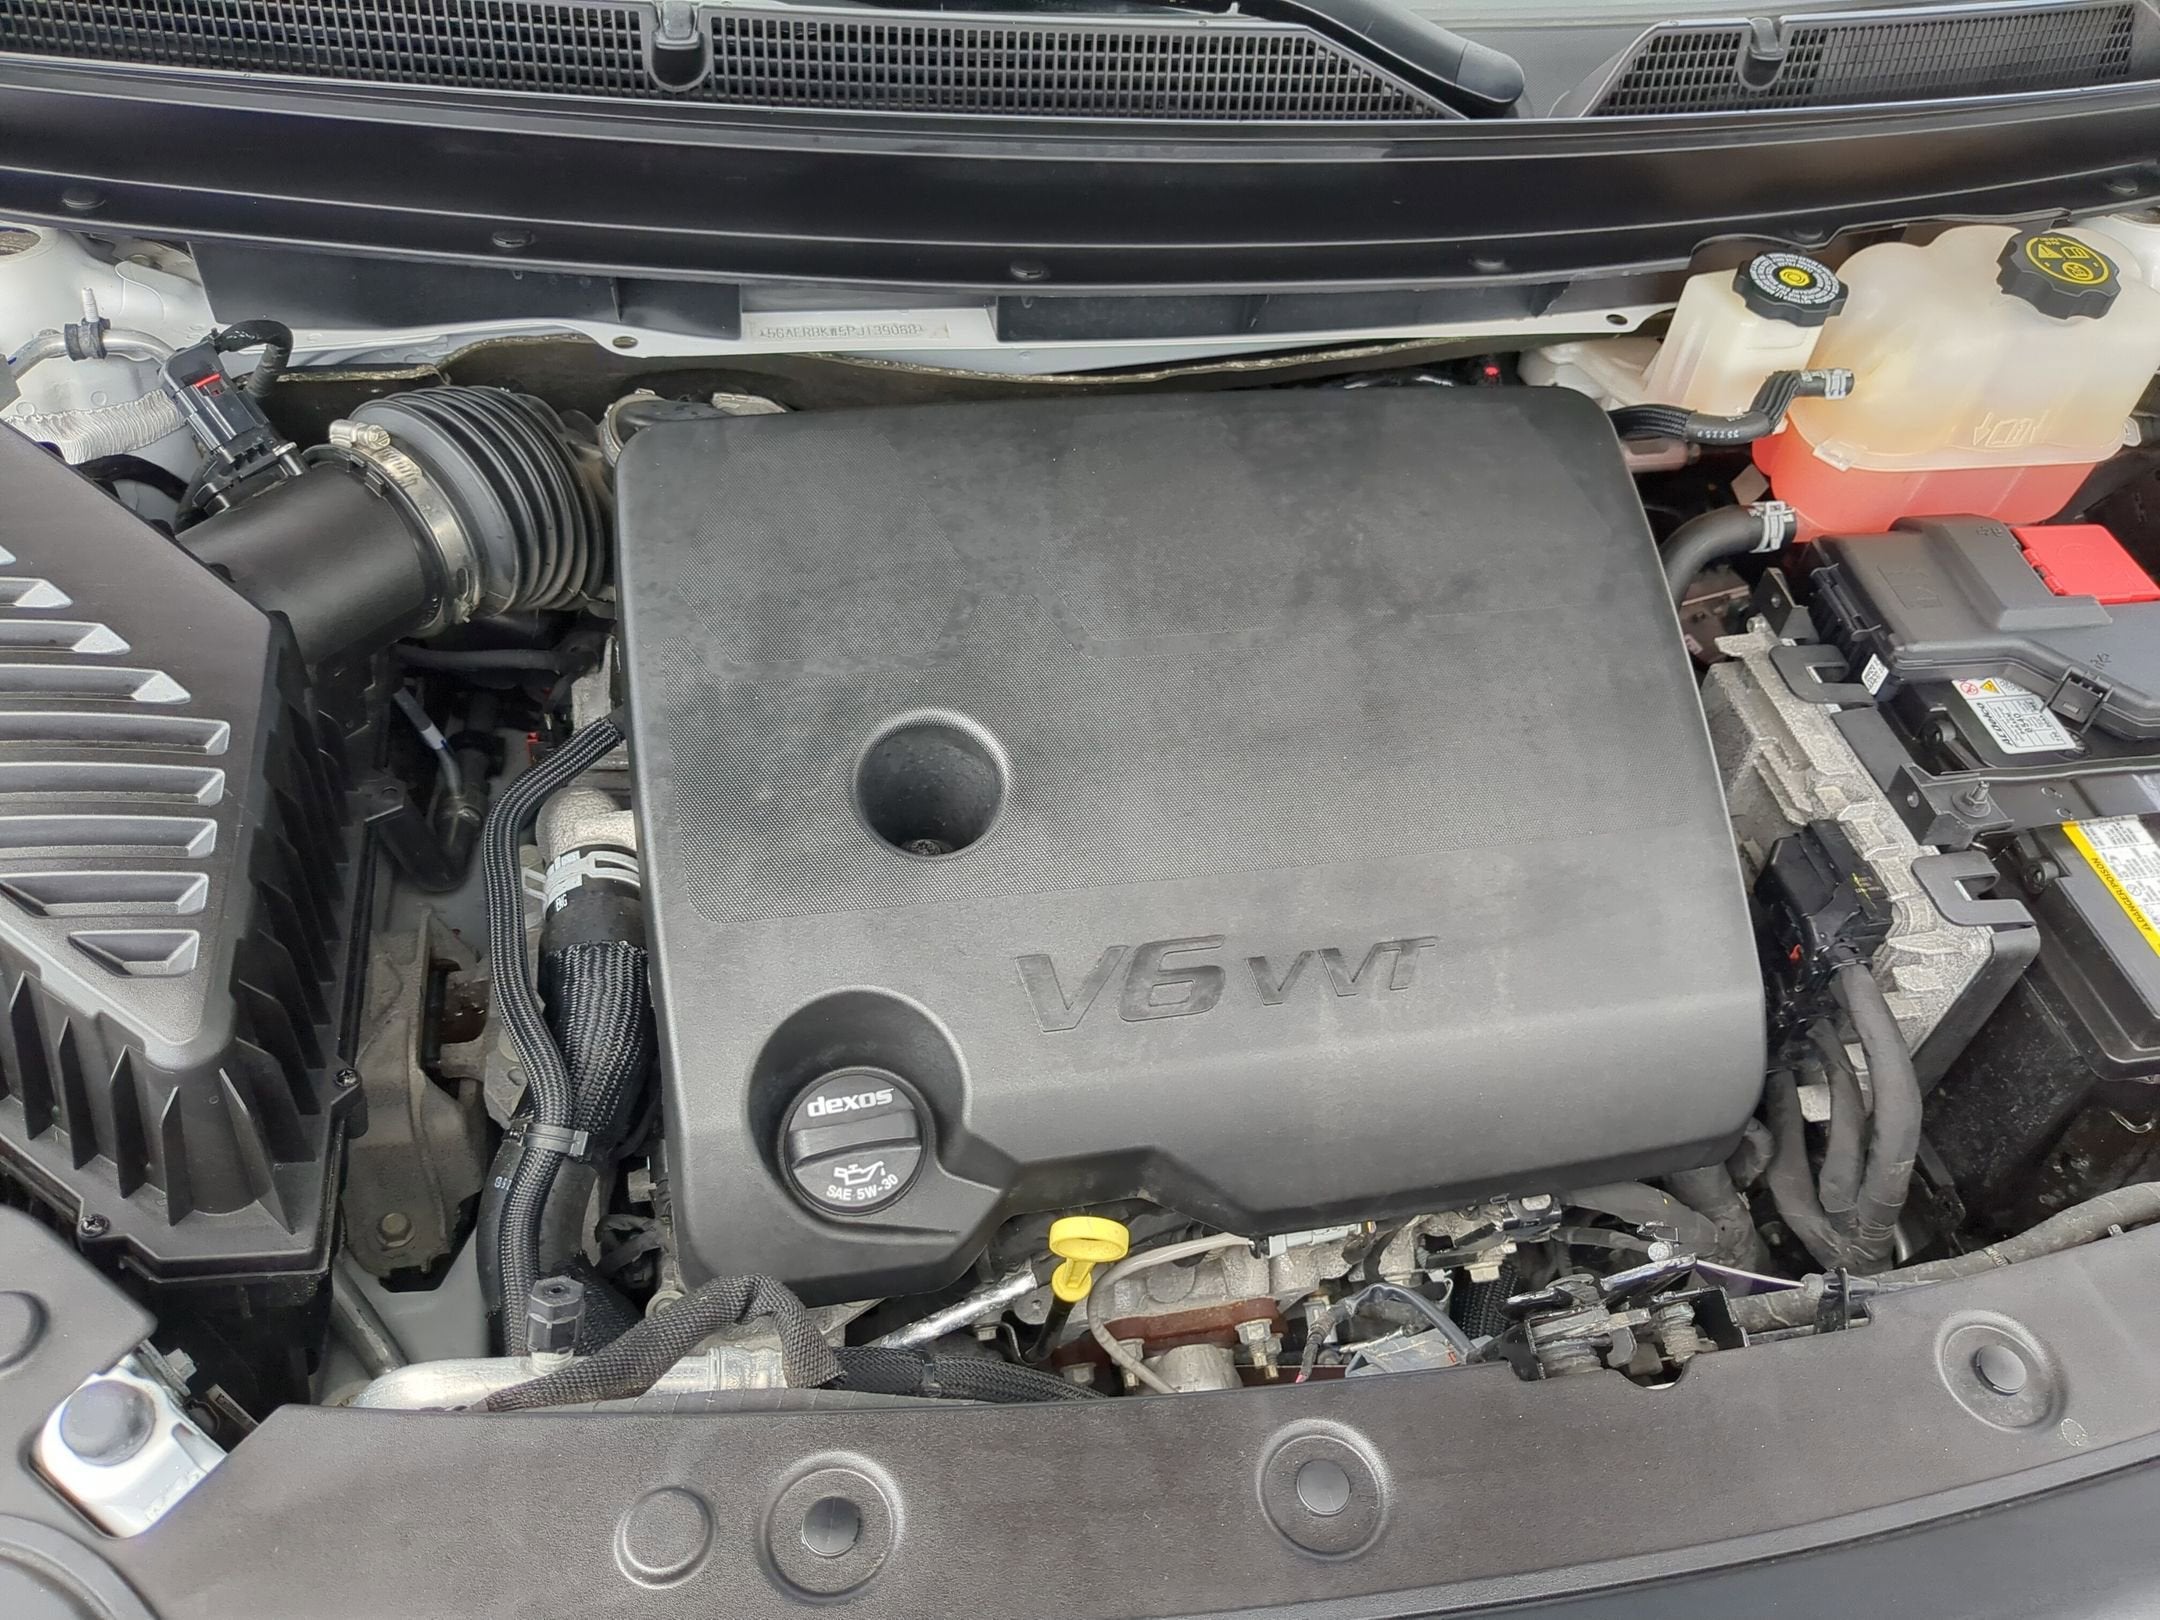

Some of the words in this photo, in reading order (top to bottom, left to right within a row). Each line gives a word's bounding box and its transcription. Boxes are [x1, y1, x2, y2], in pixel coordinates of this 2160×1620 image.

[1015, 934, 1226, 1033] V6
[1246, 935, 1439, 1007] VVT
[806, 1087, 896, 1118] dexos
[826, 1184, 853, 1202] SAE
[856, 1174, 899, 1201] 5W-30
